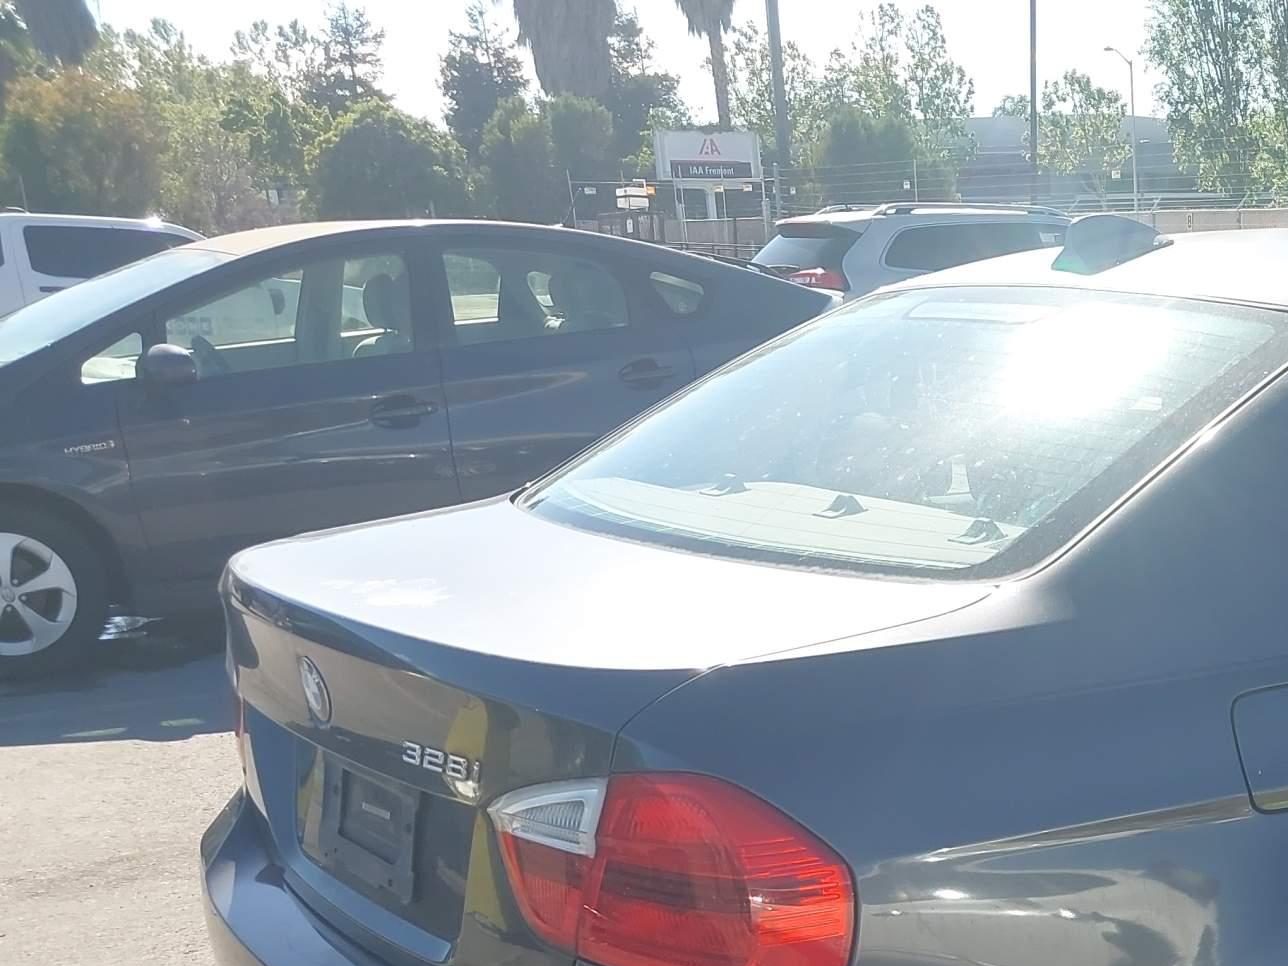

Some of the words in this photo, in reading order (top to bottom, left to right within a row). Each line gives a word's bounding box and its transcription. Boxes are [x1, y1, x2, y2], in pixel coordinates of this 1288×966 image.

[689, 166, 704, 175] IAA
[705, 166, 734, 175] Fremont
[64, 441, 107, 455] HYBRID
[402, 740, 480, 782] 328i
